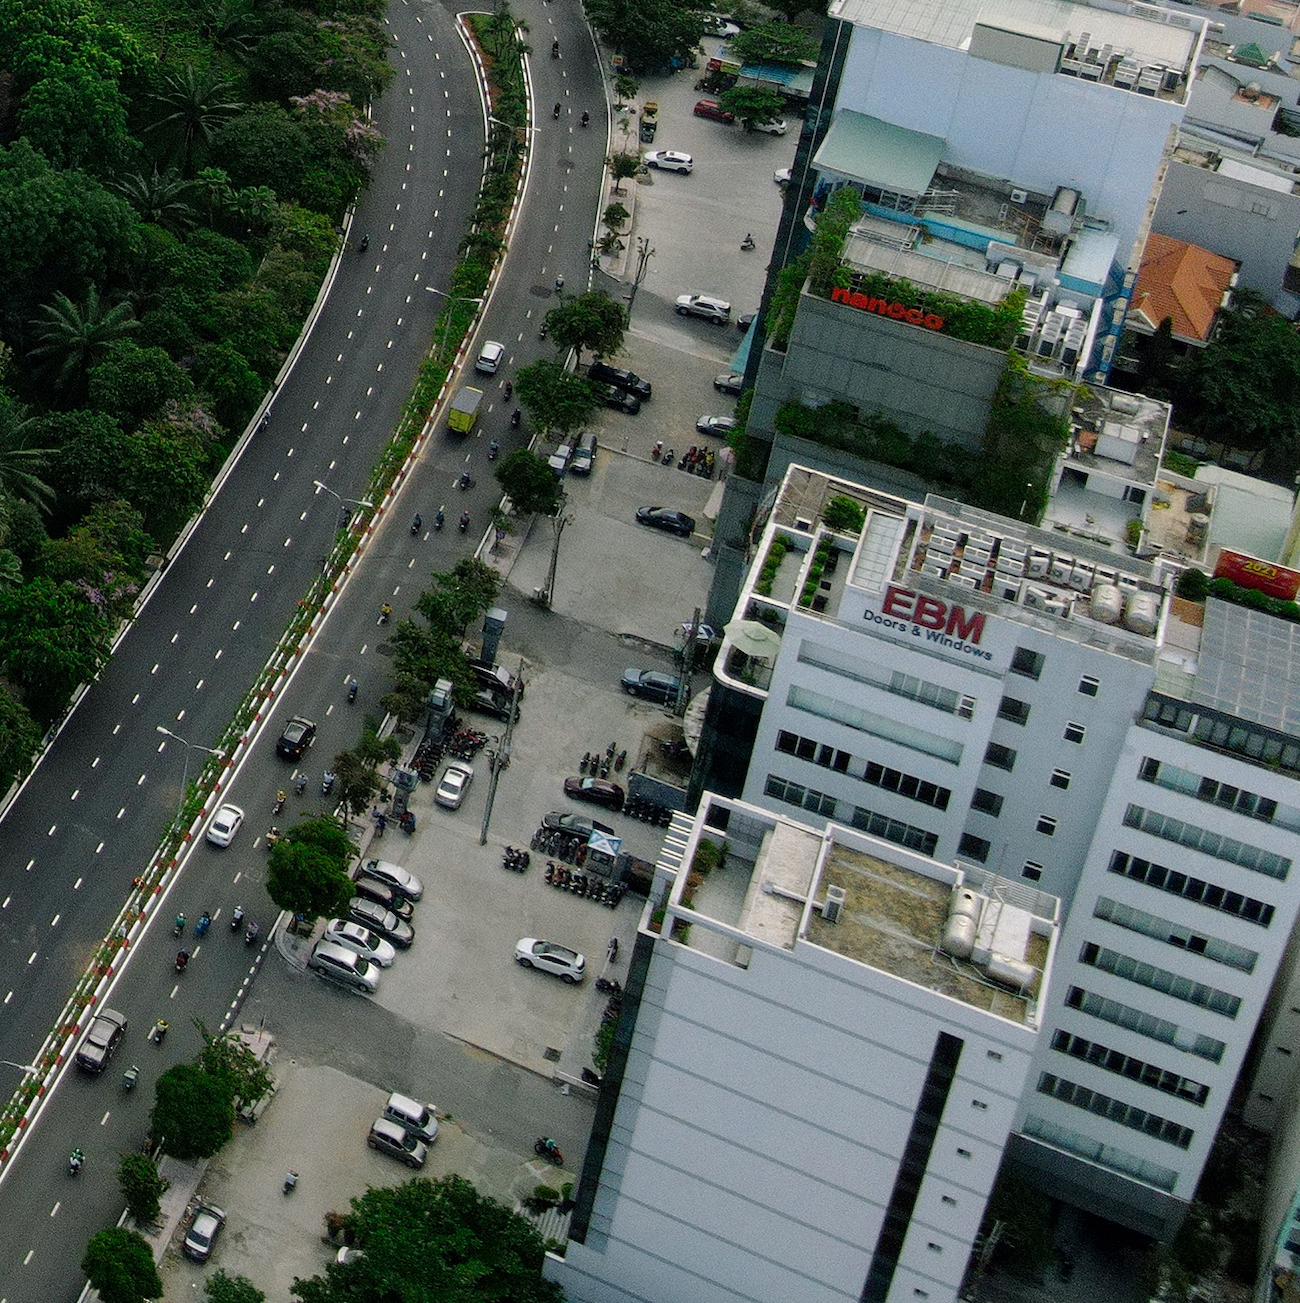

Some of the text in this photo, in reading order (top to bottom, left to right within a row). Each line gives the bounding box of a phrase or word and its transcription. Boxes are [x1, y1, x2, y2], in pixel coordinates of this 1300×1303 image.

[831, 287, 944, 330] nanoco
[1244, 560, 1278, 577] 2021
[863, 609, 993, 661] Doors & Windows
[882, 585, 986, 644] EBM
